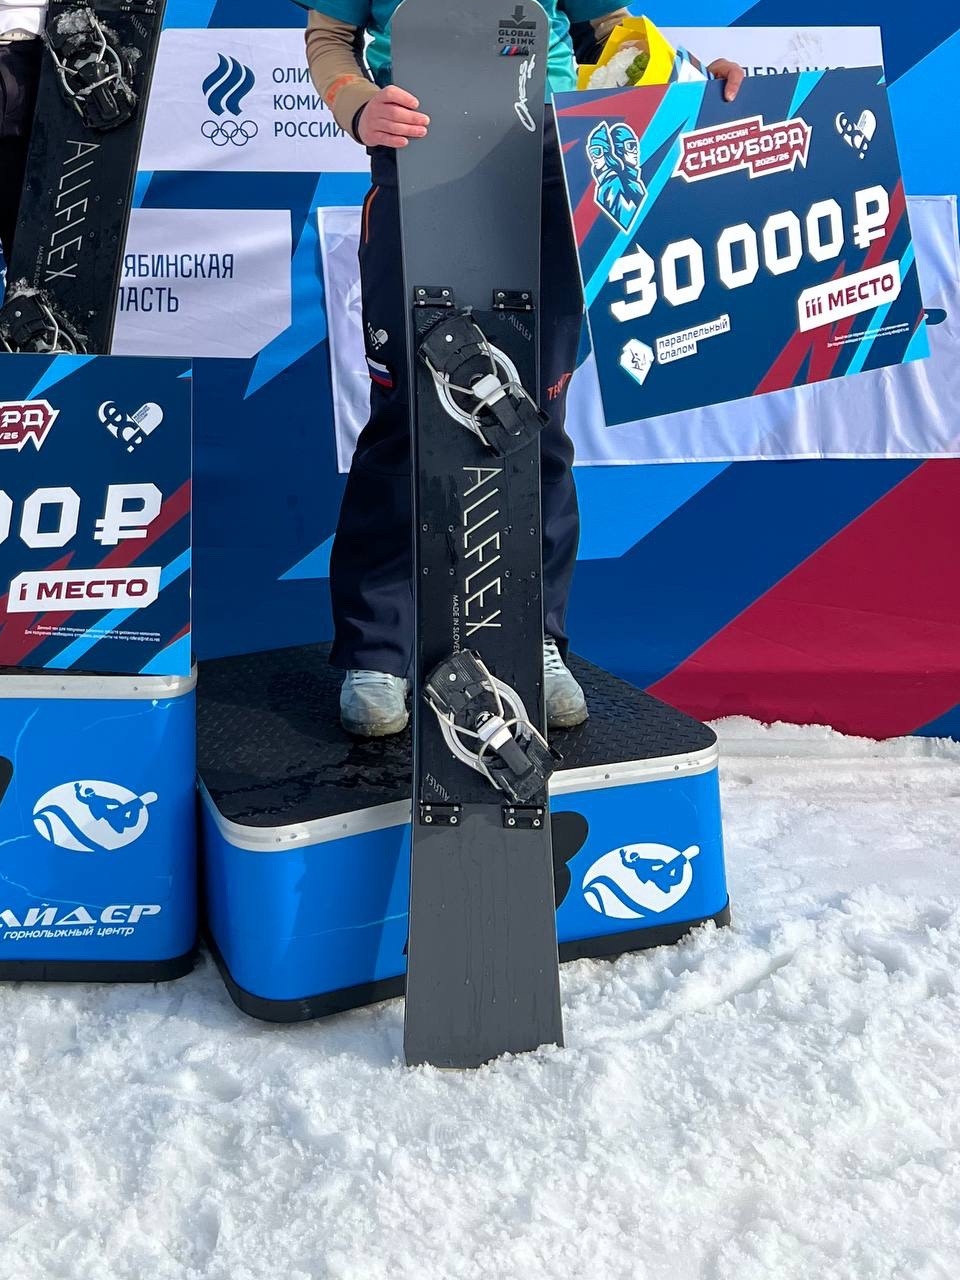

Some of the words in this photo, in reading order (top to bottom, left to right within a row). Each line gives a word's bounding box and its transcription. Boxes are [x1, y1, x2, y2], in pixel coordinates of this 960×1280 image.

[498, 29, 536, 38] GLOBAL
[272, 67, 310, 84] ОЛИ
[273, 94, 326, 111] КОМИ
[685, 127, 804, 171] СНОУБОРД
[44, 140, 101, 282] ALLFLEX
[124, 253, 234, 279] ЯБИНСКАЯ
[609, 237, 706, 322] 30
[717, 198, 845, 290] 000
[828, 273, 894, 311] МЕСТО
[658, 318, 728, 350] параллельный
[659, 342, 695, 361] слалом
[463, 466, 503, 637] ALLFLEX
[36, 578, 149, 601] МЕСТО
[452, 594, 460, 617] MADE
[3, 926, 94, 940] горнолыжный
[96, 926, 135, 938] центр
